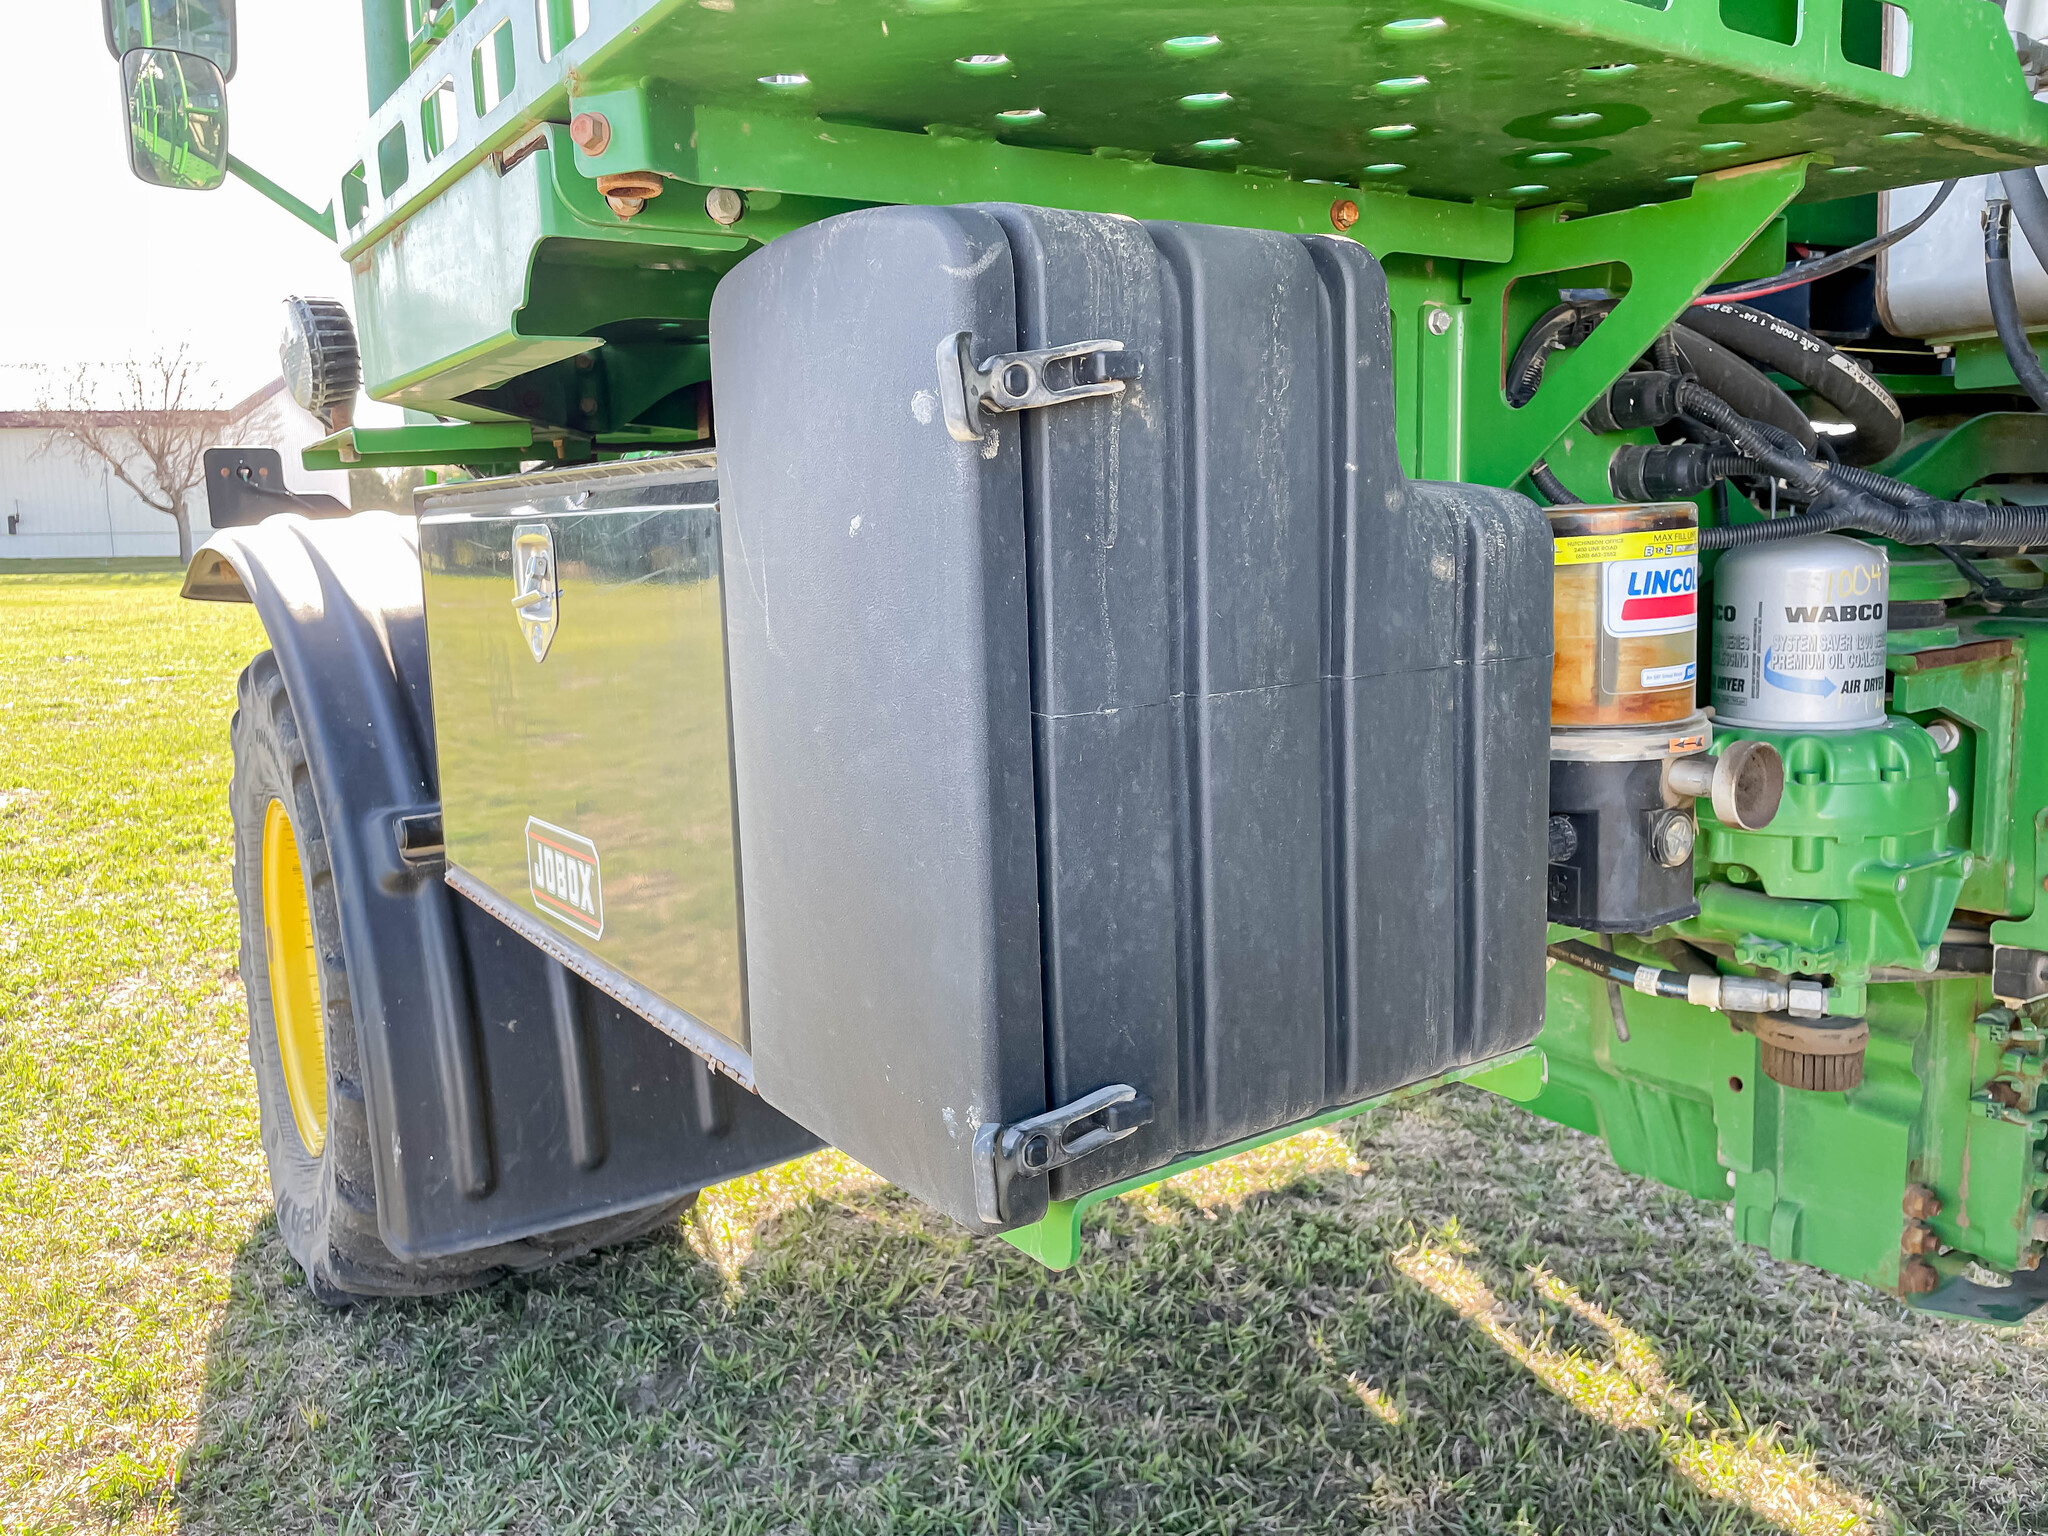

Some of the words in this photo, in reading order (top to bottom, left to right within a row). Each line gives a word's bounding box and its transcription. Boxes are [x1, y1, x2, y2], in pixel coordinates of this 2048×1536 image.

[1770, 323, 1799, 341] 100R4
[1800, 336, 1820, 352] SAE
[1653, 534, 1673, 542] MAX
[1674, 532, 1687, 540] FILL
[1785, 603, 1883, 623] WABCO
[1772, 634, 1817, 652] SYSTEM
[1819, 634, 1853, 651] SAVER
[1772, 653, 1825, 670] PREMIUM
[1828, 653, 1845, 669] OIL
[1841, 680, 1861, 693] AIR
[534, 842, 595, 915] JOBOX
